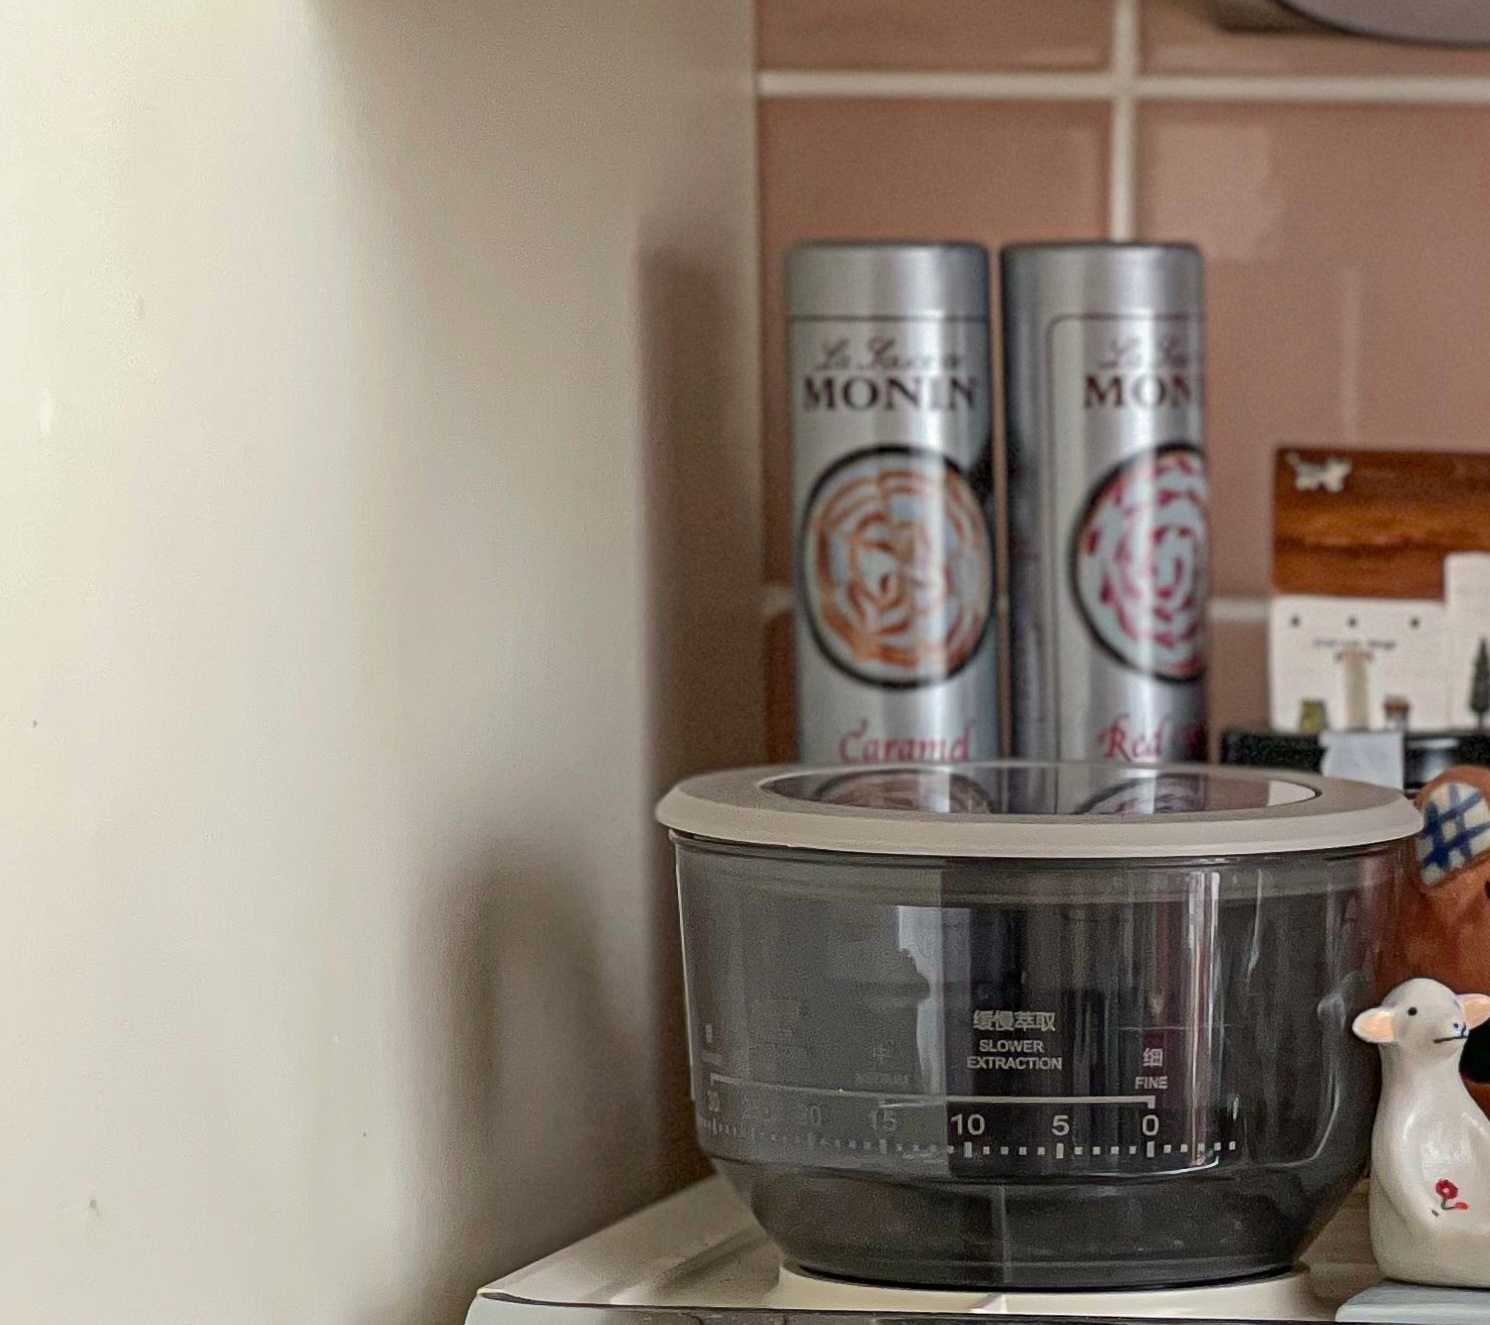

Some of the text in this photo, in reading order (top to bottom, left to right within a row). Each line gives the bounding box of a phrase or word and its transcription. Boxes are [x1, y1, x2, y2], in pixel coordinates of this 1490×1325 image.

[973, 1009, 1056, 1032] 缓慢萃取
[979, 1039, 1045, 1053] SLOWER
[966, 1056, 1063, 1071] EXTRACTION
[1143, 1047, 1163, 1068] 细
[1134, 1075, 1168, 1090] FINE
[950, 1113, 986, 1136] 10
[1051, 1114, 1070, 1136] 5
[1141, 1114, 1160, 1137] 0
